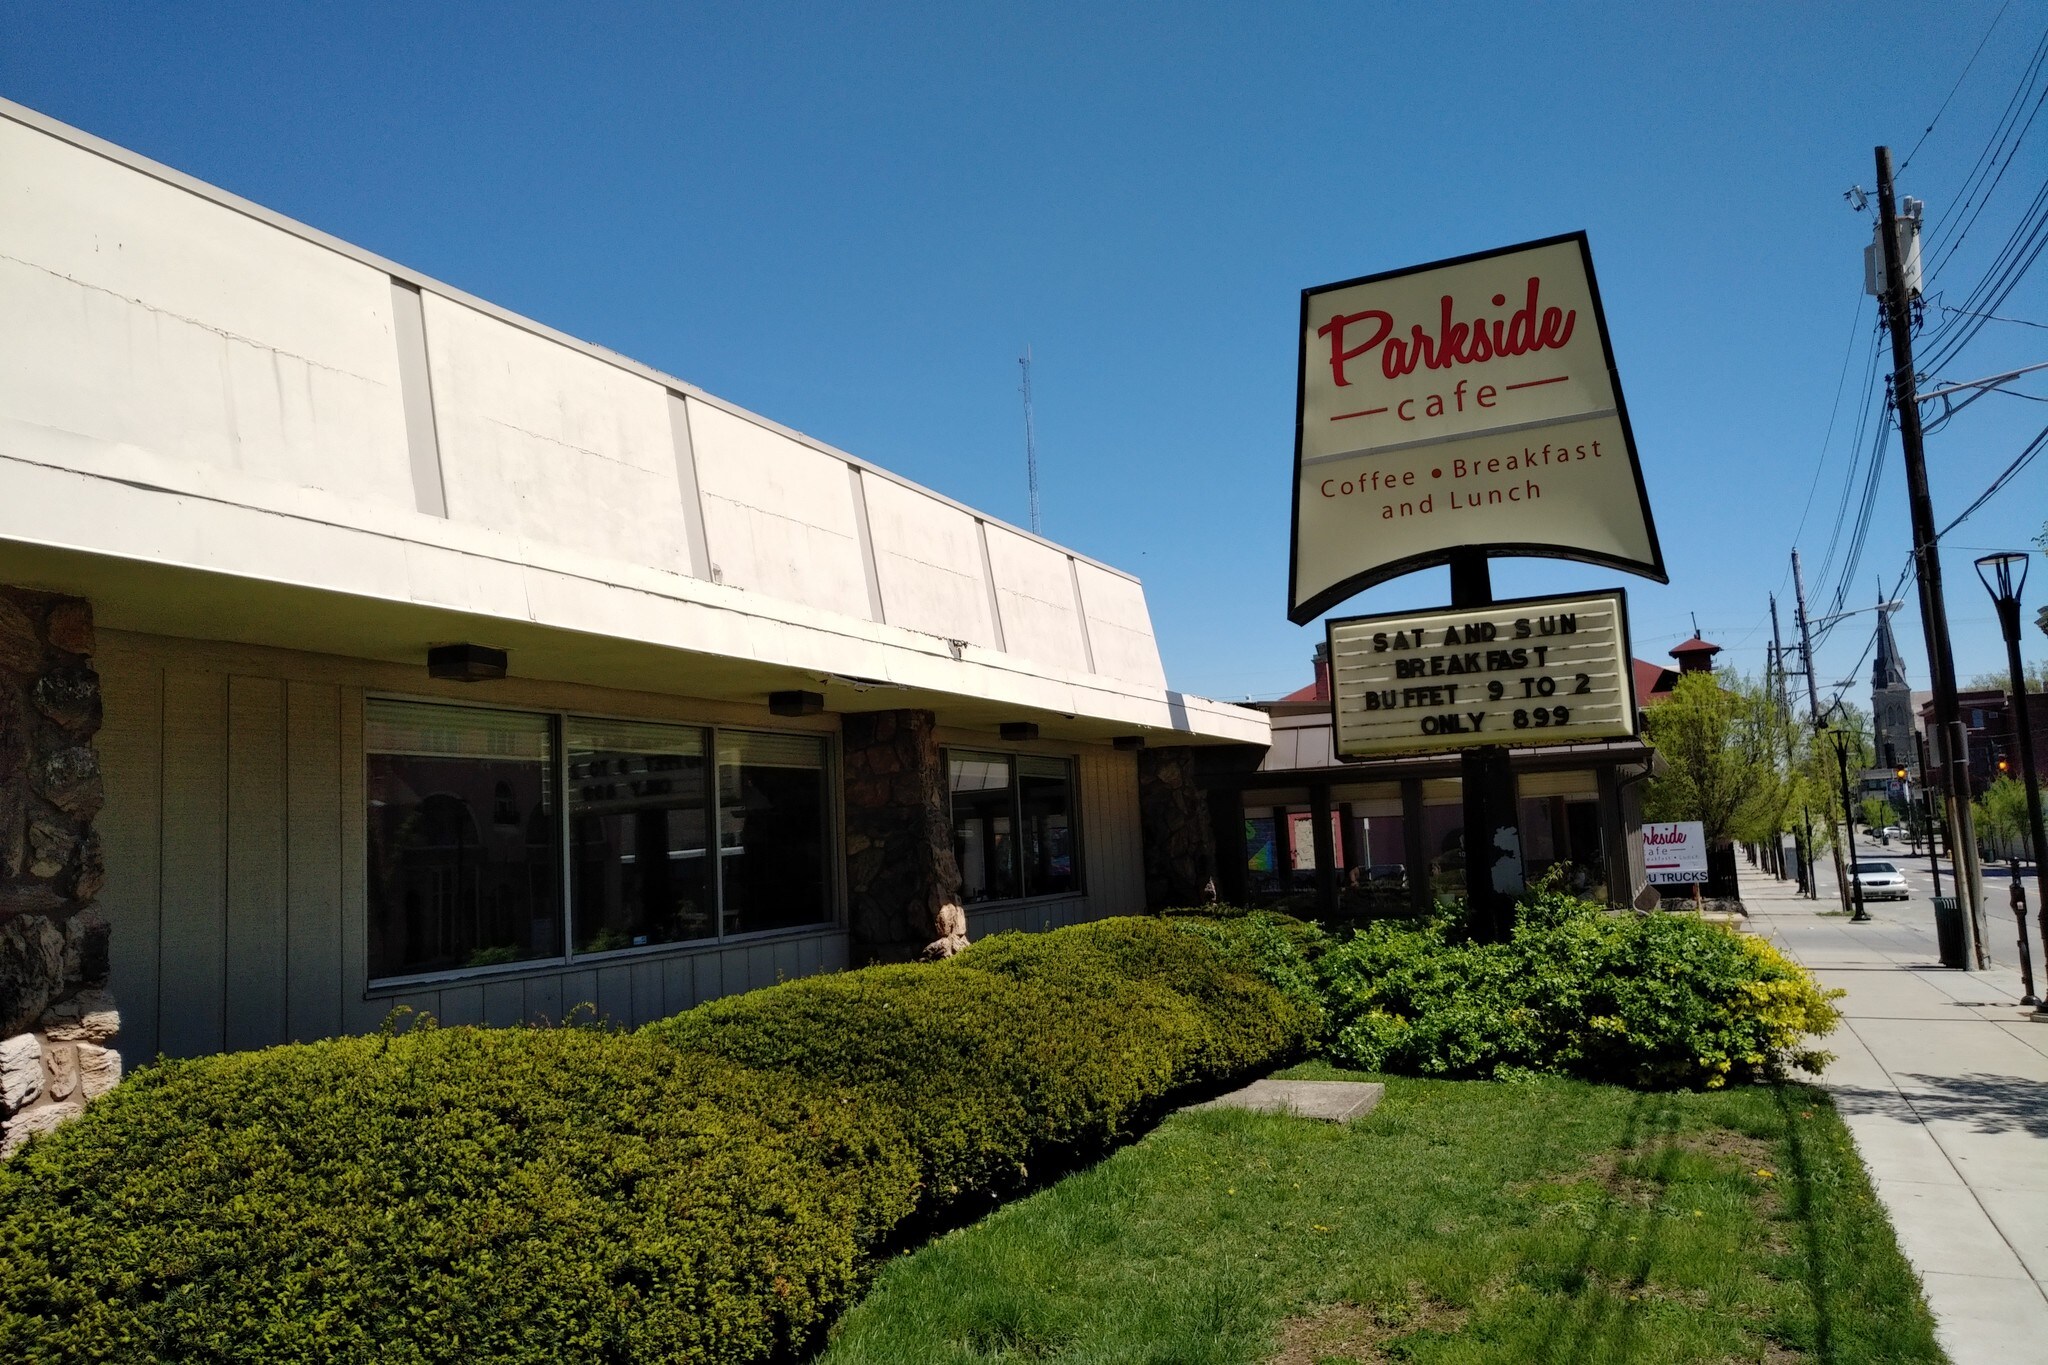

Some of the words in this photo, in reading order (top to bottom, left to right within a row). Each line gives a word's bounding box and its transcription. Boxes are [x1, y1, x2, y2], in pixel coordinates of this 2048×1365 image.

[1318, 277, 1576, 387] Parkside
[1397, 379, 1497, 421] cafe
[1321, 471, 1415, 498] Coffee
[1453, 440, 1602, 479] Breakfast
[1382, 494, 1434, 520] and
[1450, 479, 1541, 510] Lunch
[1373, 628, 1425, 651] SAT
[1444, 621, 1497, 646] AND
[1515, 613, 1577, 639] SUN
[1395, 646, 1548, 679] BREAKFAST
[1365, 684, 1459, 711] BUFFET
[1487, 680, 1504, 701] 9
[1520, 676, 1557, 699] TO
[1575, 673, 1592, 695] 2
[1420, 711, 1486, 735] ONLY
[1513, 705, 1571, 729] 899
[1643, 824, 1687, 845] rkside
[1644, 847, 1668, 857] afe
[1660, 872, 1708, 882] TRUCKS
